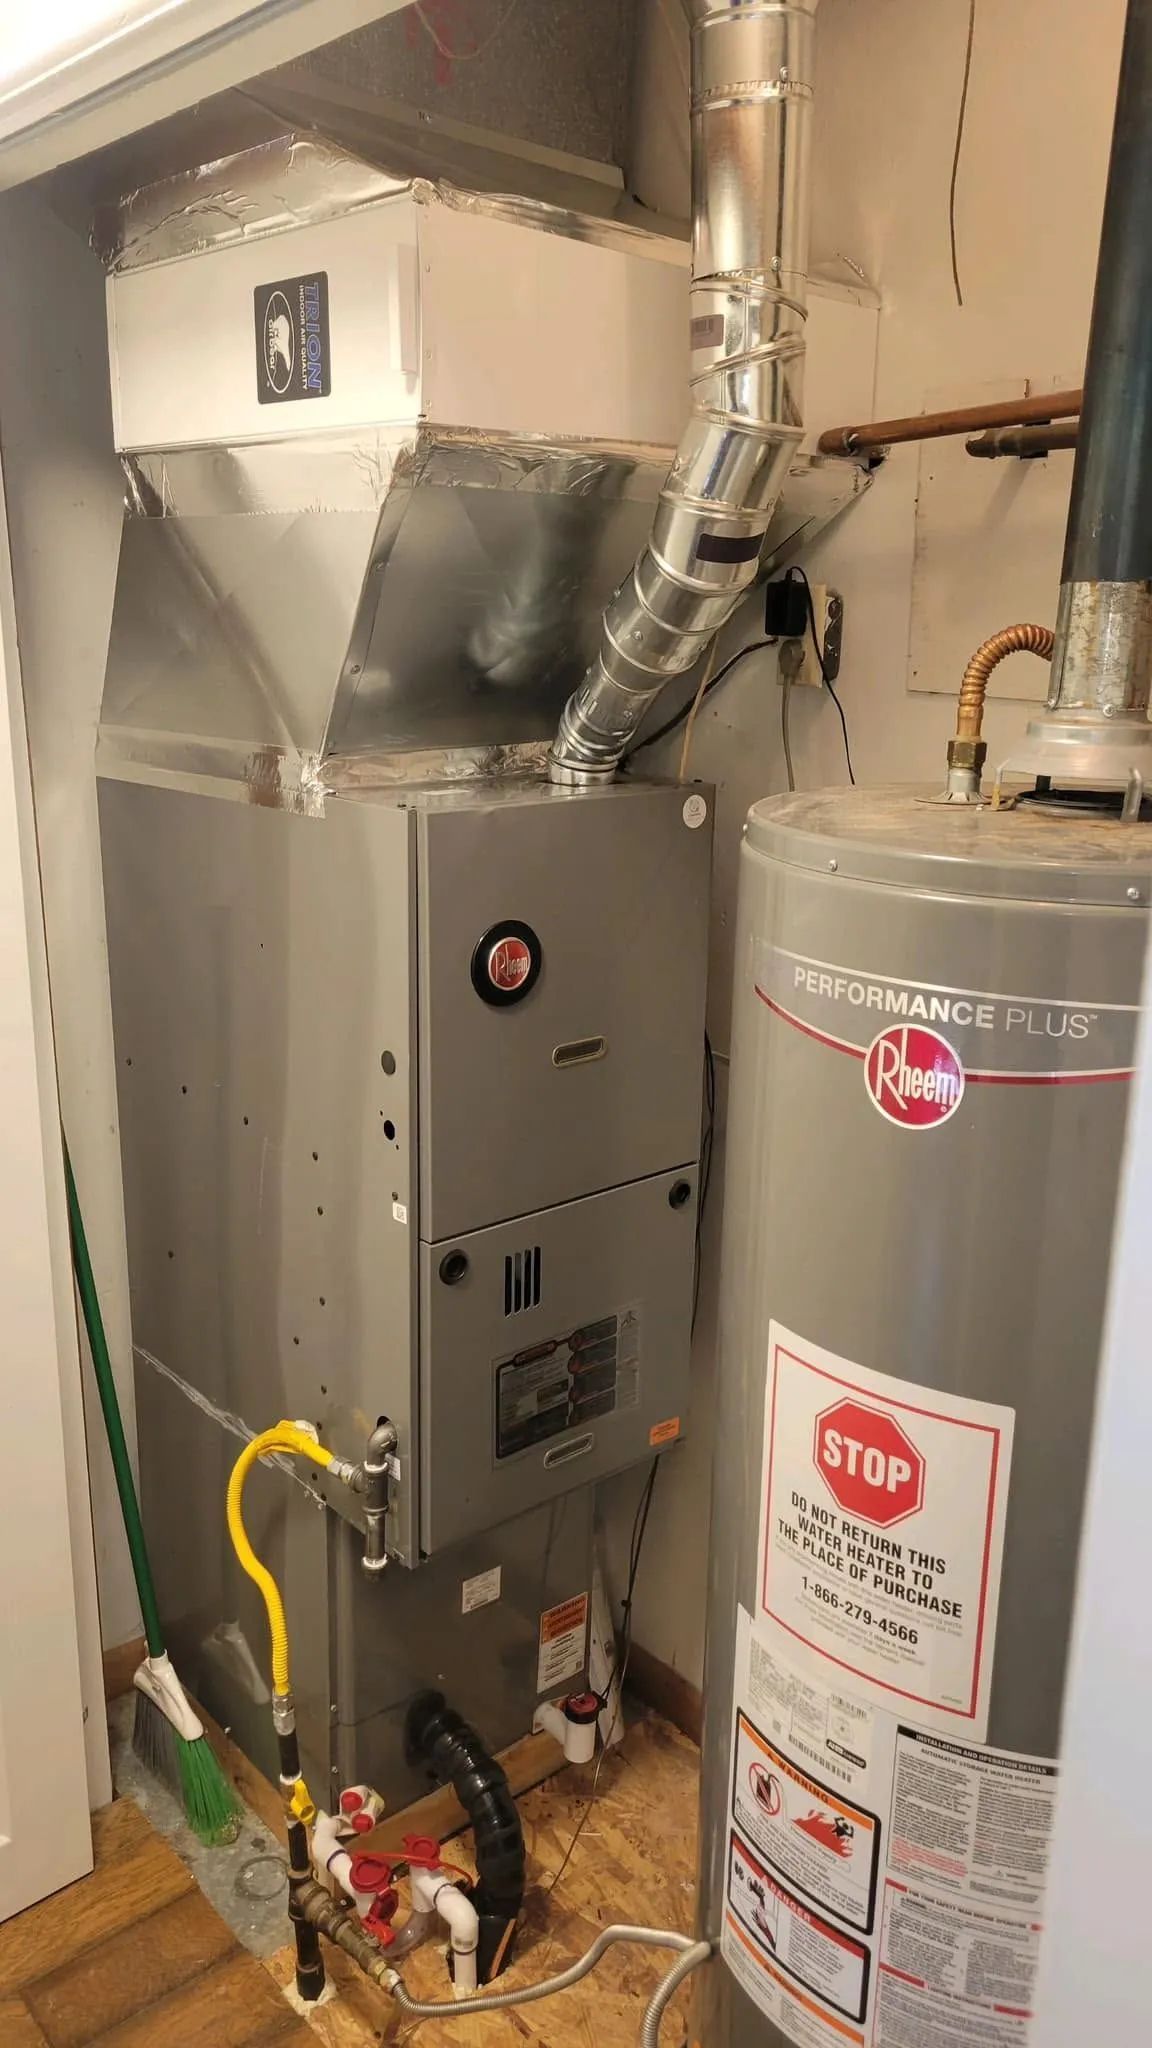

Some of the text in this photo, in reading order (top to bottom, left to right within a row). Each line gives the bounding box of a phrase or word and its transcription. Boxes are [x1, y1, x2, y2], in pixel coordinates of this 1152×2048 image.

[305, 282, 321, 390] TRION
[495, 943, 528, 982] Rheem
[793, 966, 995, 1029] PERFORMANCE
[875, 1027, 956, 1110] Rheem
[823, 1428, 911, 1494] STOP
[791, 1491, 947, 1575] DO NOT RETURN THIS
[798, 1514, 933, 1591] WATER HEATER TO
[778, 1518, 799, 1545] THE
[803, 1536, 844, 1572] PLACE
[849, 1563, 868, 1582] OF
[873, 1575, 963, 1619] PURCHASE
[801, 1576, 919, 1645] 1-866-279-4566
[779, 1760, 830, 1804] WARNING
[916, 1734, 1047, 1775] INSTALLATION AND OPERATION DETAILS
[921, 1747, 1041, 1785] AUTOMATIC STORAGE WATER HEATER
[770, 1882, 811, 1922] DANGER
